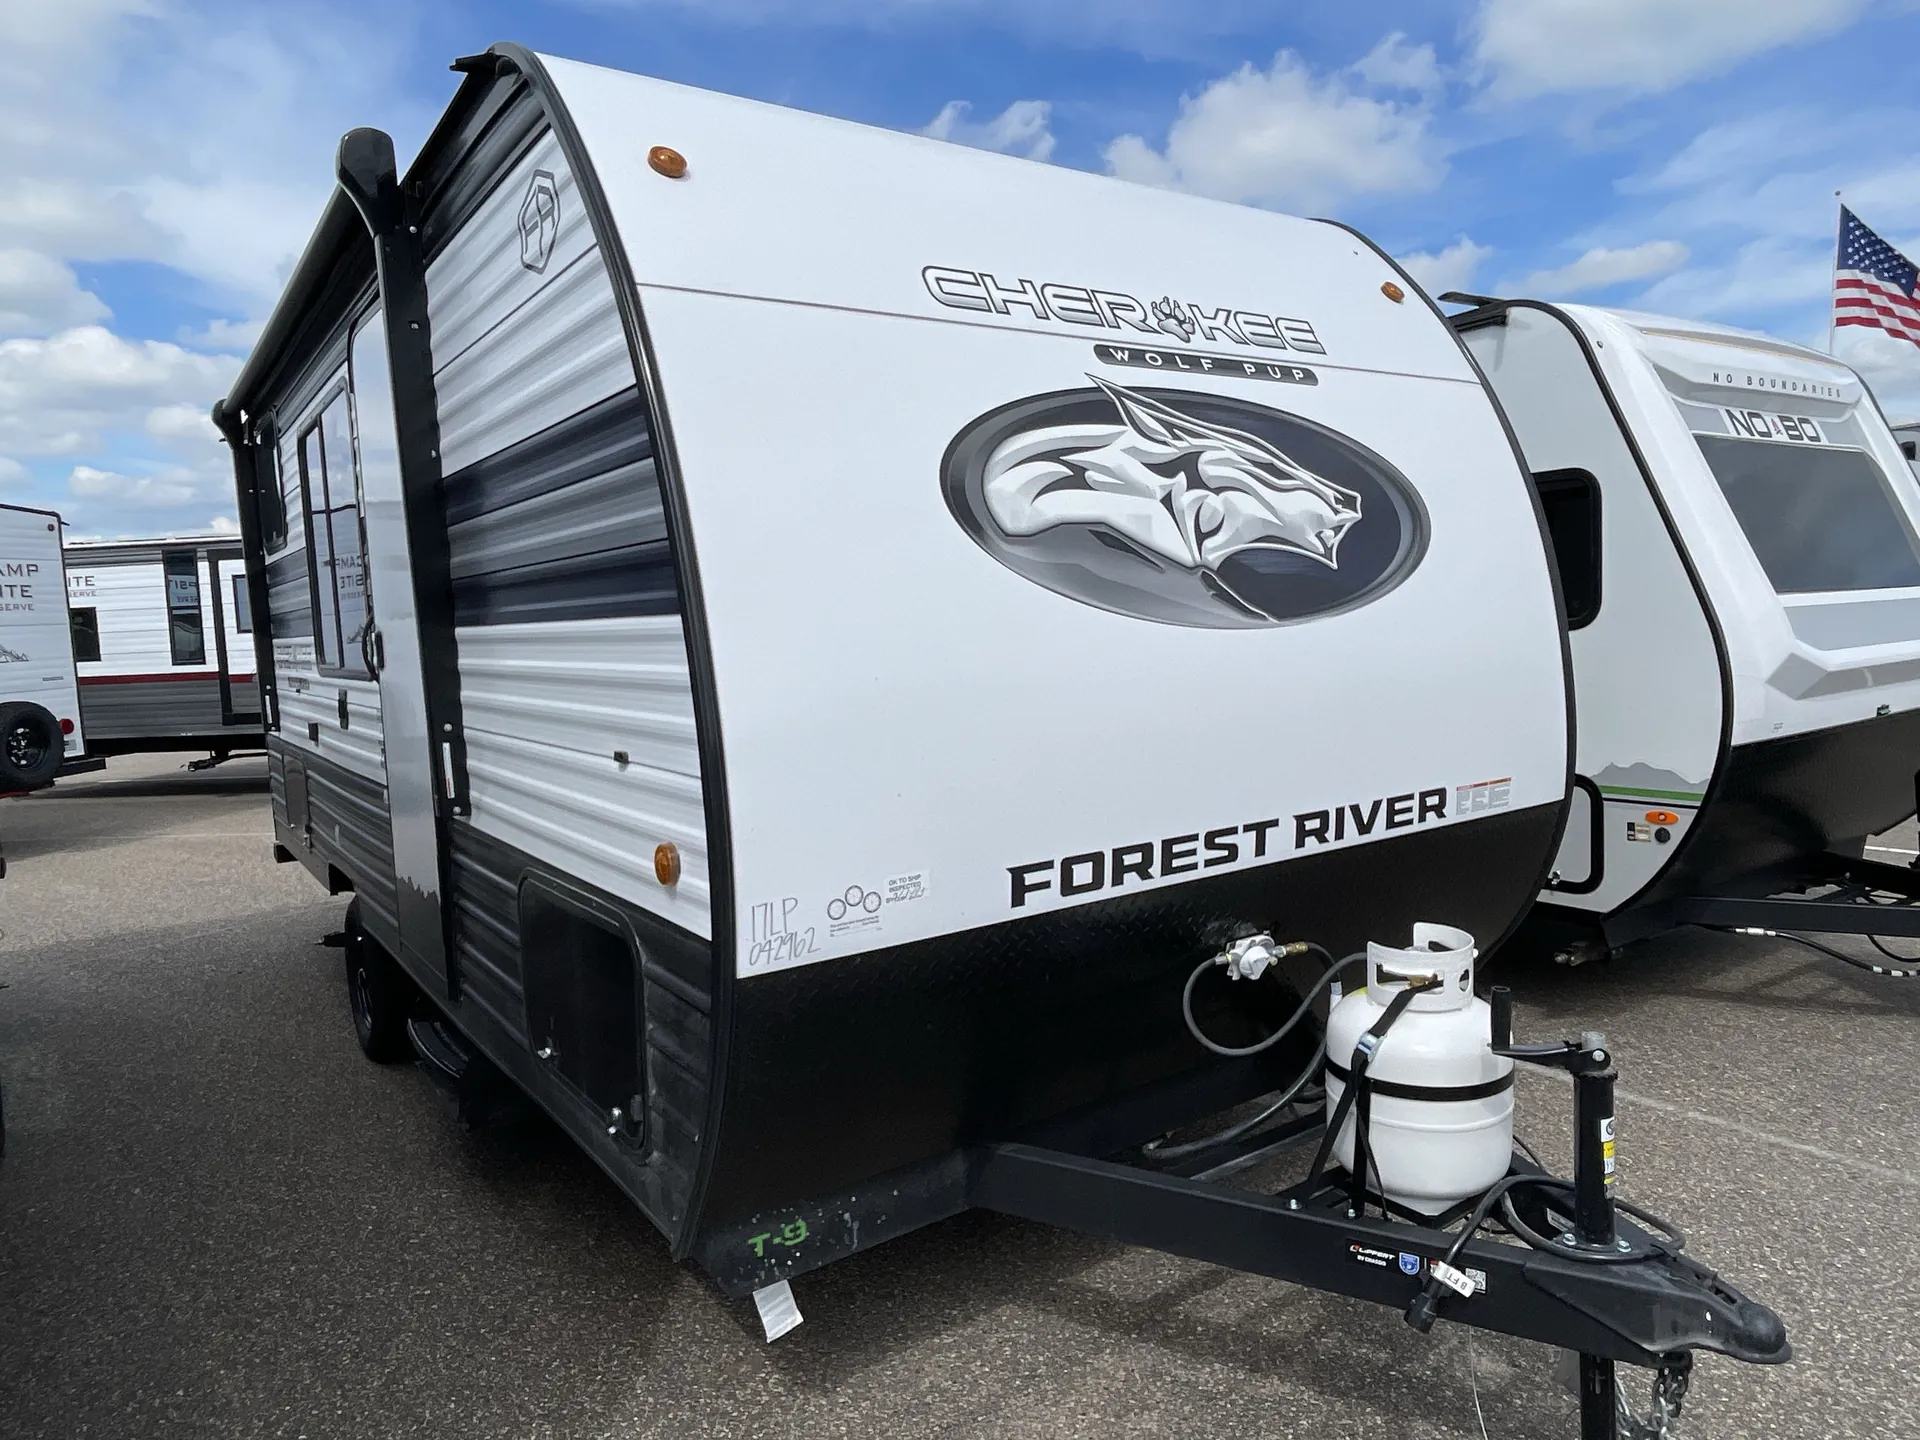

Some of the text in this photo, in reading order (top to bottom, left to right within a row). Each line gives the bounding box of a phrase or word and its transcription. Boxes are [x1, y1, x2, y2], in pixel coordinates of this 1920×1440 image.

[1108, 346, 1305, 382] WOLF PUP
[1713, 372, 1841, 399] NO BOUNDARIES
[1005, 818, 1280, 909] FOREST
[1293, 787, 1447, 850] RIVER
[749, 927, 823, 966] 042962
